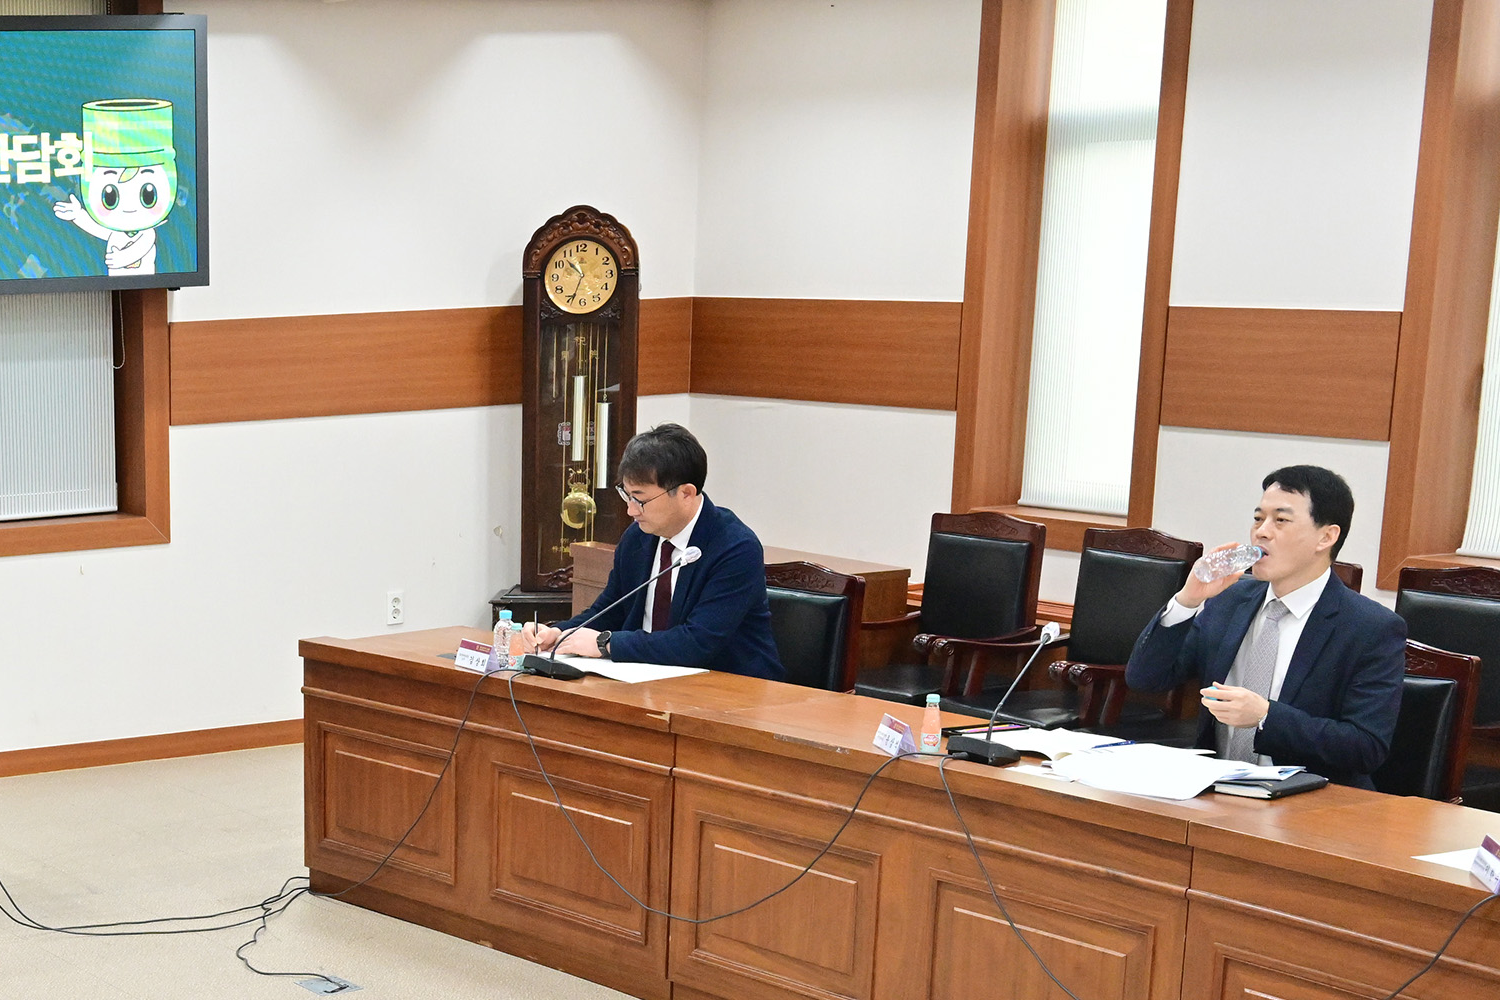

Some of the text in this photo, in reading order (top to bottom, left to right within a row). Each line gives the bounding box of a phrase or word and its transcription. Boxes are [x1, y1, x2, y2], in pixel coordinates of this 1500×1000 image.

[576, 243, 587, 252] 12
[564, 249, 572, 258] 11
[555, 260, 564, 269] 10
[602, 257, 609, 265] 2
[552, 274, 559, 282] 9
[605, 270, 613, 278] 3
[555, 286, 563, 294] 8
[592, 293, 601, 302] 5
[579, 298, 586, 306] 6
